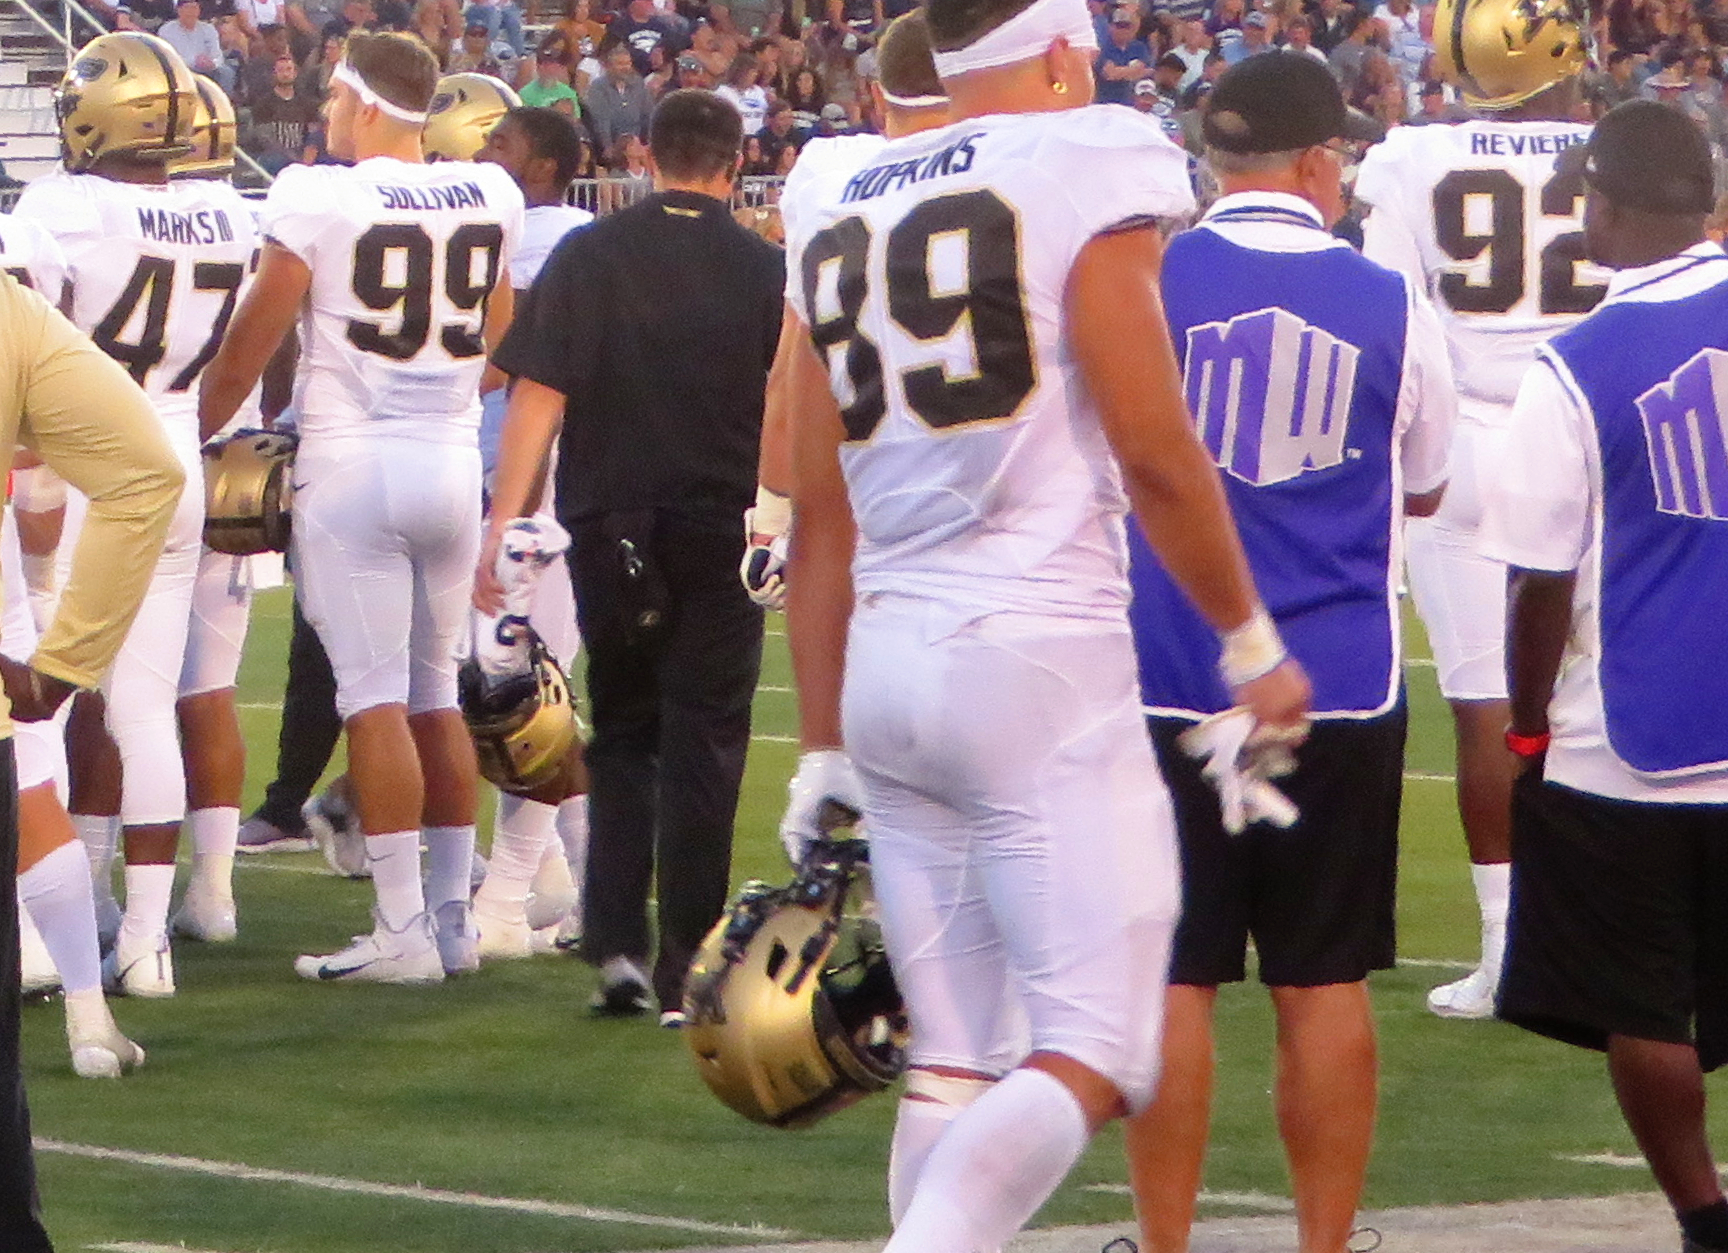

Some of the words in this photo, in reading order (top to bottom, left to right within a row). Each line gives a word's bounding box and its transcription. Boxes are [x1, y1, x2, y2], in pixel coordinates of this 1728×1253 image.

[136, 206, 215, 245] MARKS
[375, 180, 488, 211] SULLIVAN
[840, 132, 987, 204] HOPKINS
[344, 222, 506, 363] 99
[1433, 168, 1608, 316] 92
[92, 254, 246, 393] 47
[800, 187, 1039, 445] 89
[1182, 306, 1361, 487] MW
